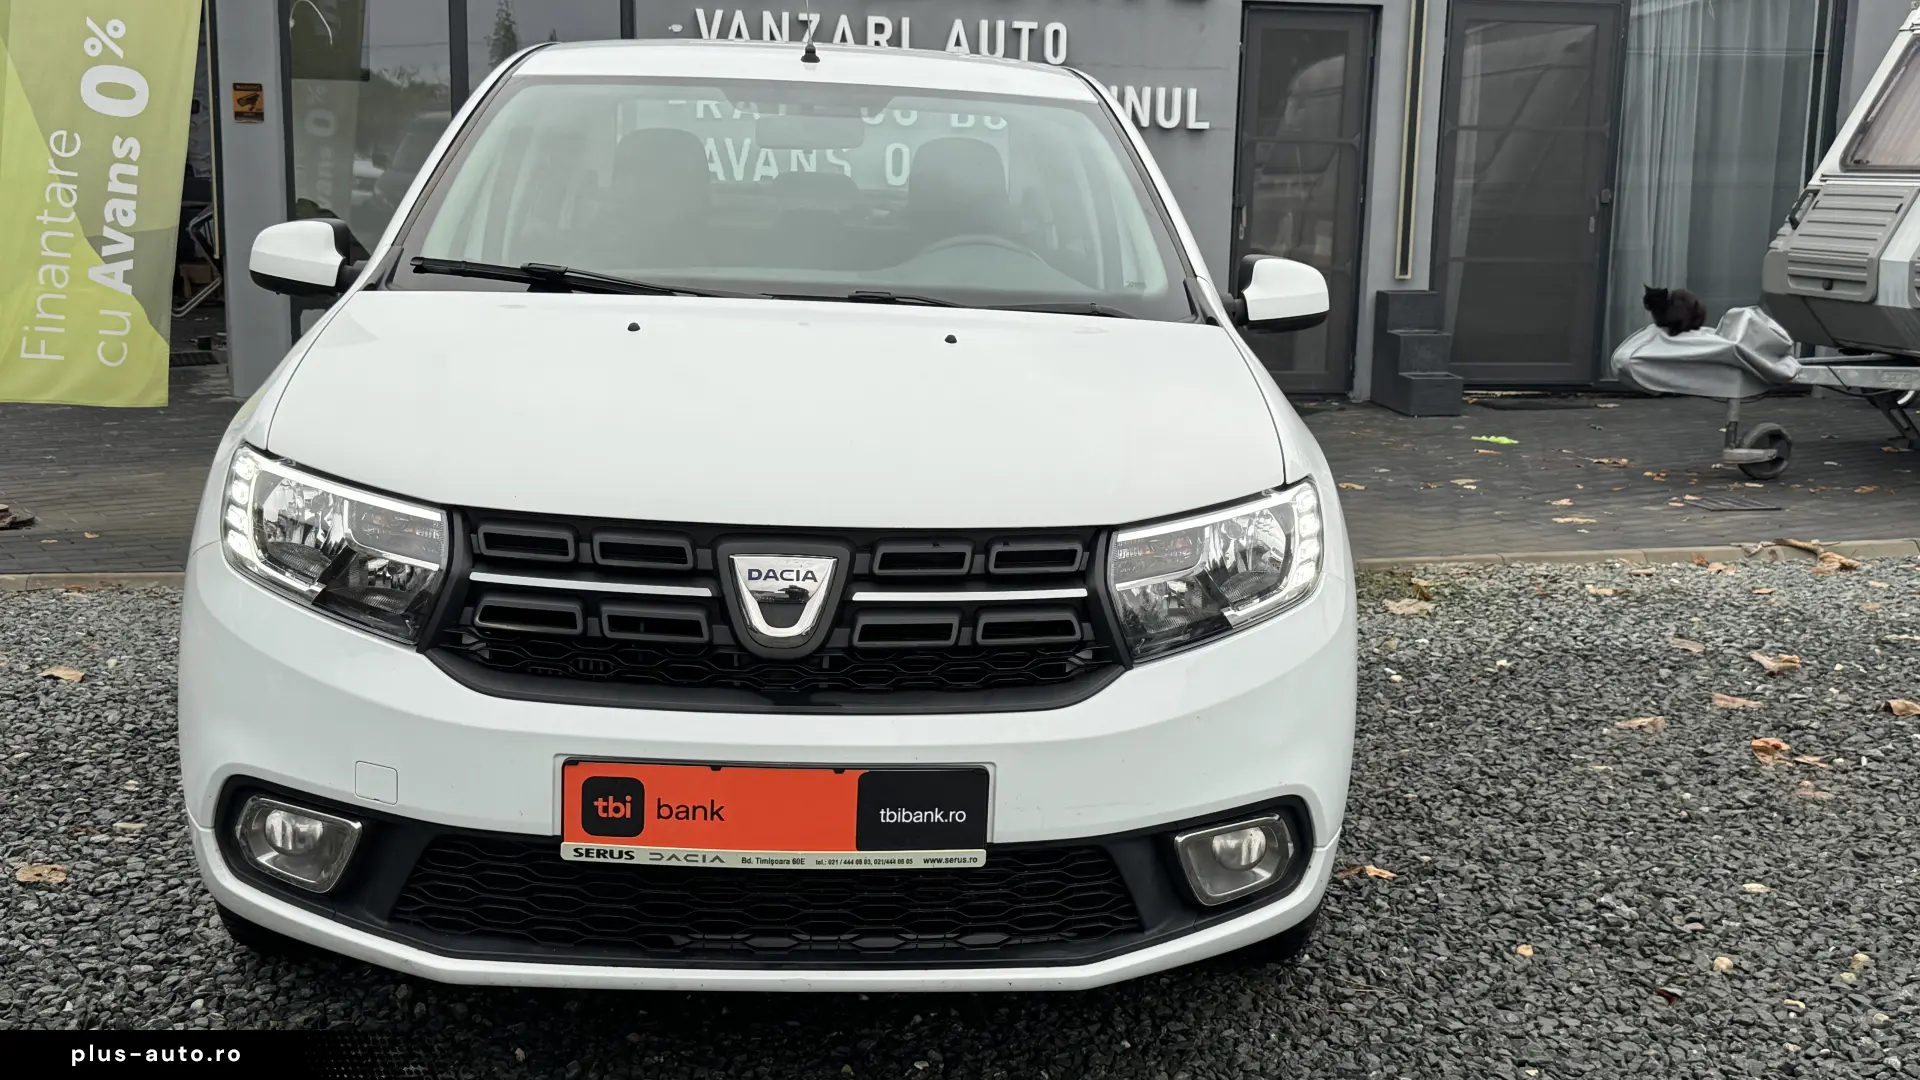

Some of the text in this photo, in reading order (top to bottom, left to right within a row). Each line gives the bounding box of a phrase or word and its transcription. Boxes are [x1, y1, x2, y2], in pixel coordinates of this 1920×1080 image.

[945, 18, 1067, 65] AUTO
[81, 17, 149, 367] cu Avans 0%
[747, 568, 818, 583] DACIA
[593, 795, 725, 821] tbi bank
[879, 807, 967, 823] tbibank.ro
[573, 847, 635, 860] SERUS
[741, 856, 753, 864] Bd.
[923, 856, 978, 864] www.serus.ro
